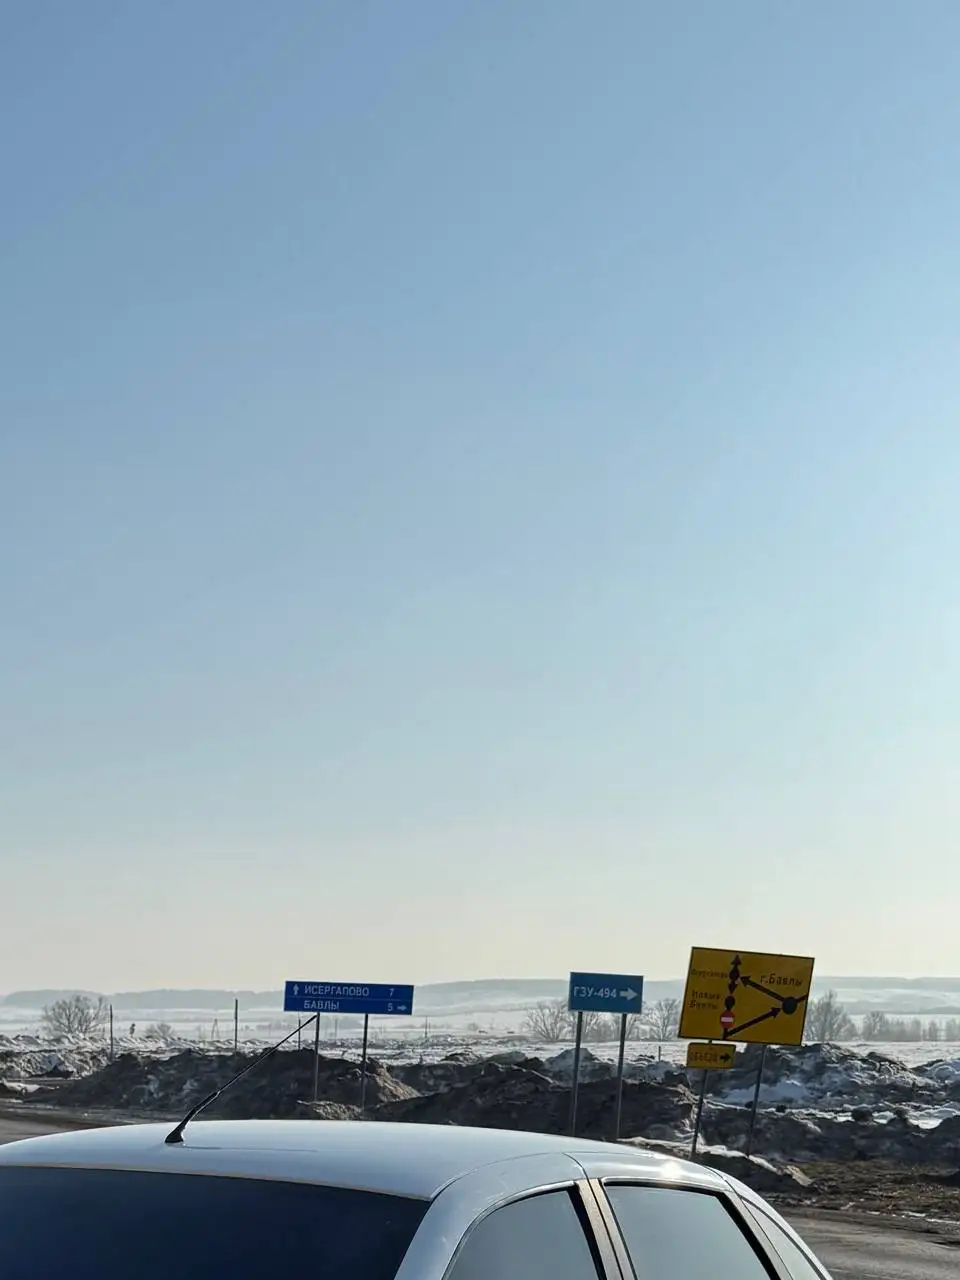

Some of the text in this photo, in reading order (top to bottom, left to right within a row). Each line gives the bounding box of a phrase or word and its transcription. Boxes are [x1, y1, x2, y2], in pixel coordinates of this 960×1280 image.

[304, 985, 395, 997] ИСЕРГАПОВО 7
[573, 986, 617, 998] ГЗУ-494
[303, 999, 394, 1012] БАВЛЫ 5
